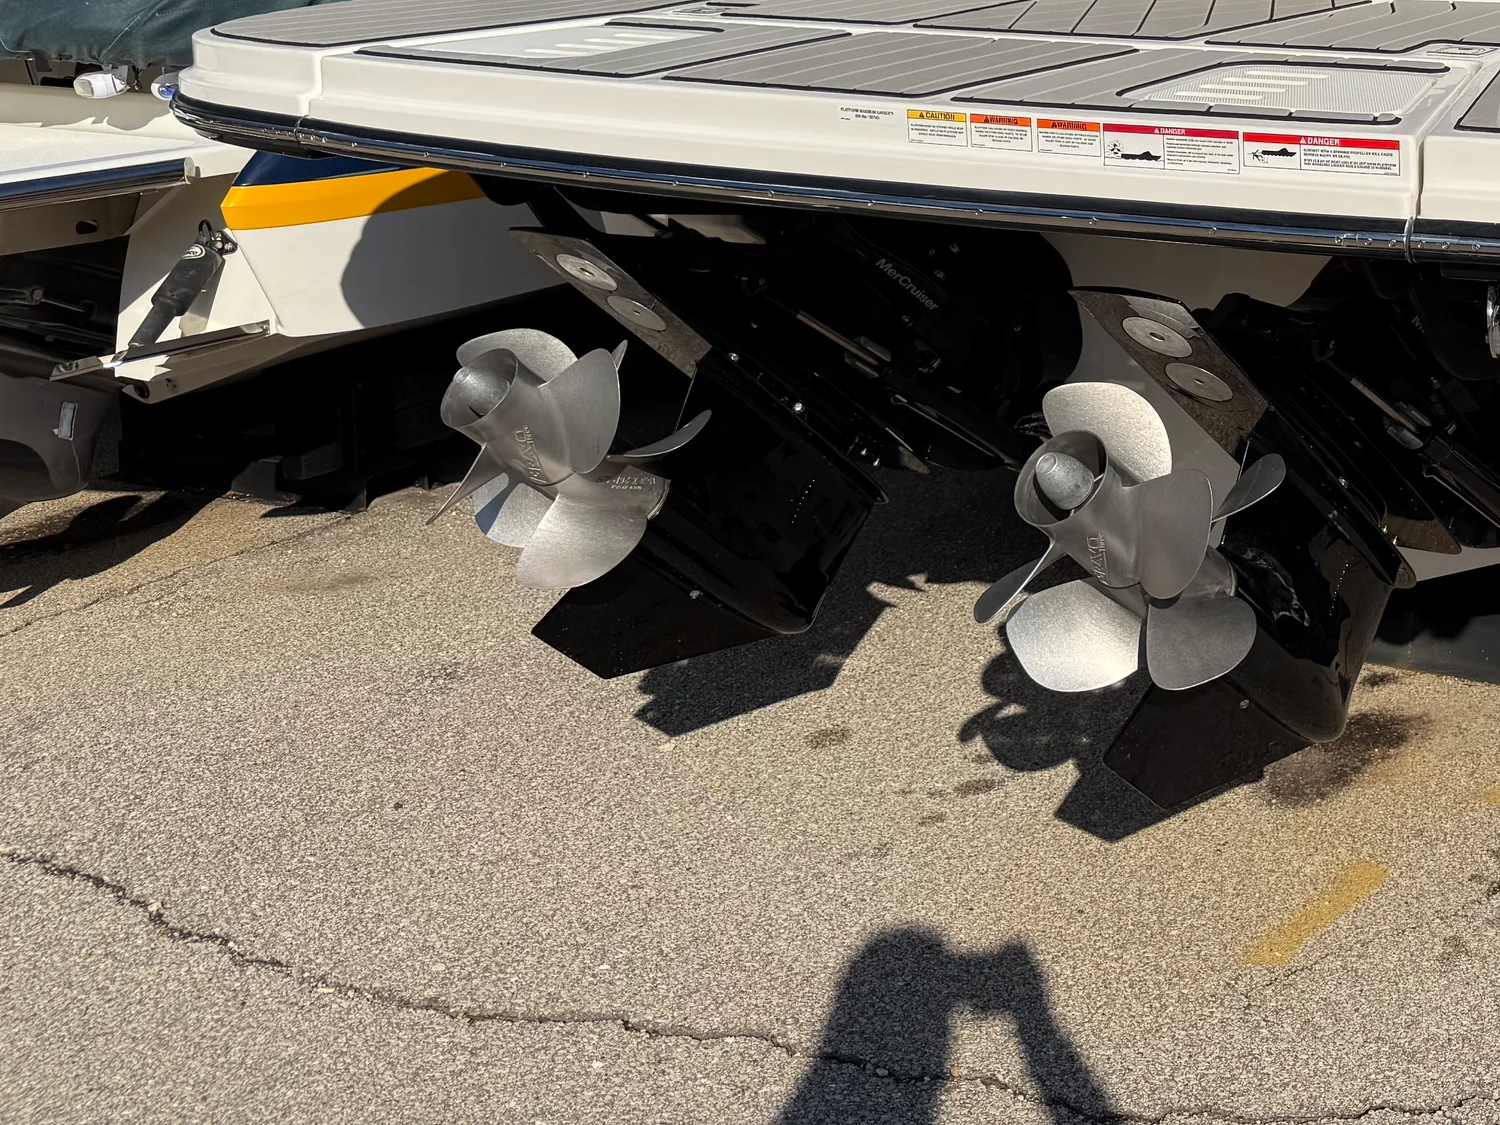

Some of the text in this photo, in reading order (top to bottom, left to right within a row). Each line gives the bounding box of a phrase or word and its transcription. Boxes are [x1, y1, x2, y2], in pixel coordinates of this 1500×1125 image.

[926, 111, 955, 120] CAUTION
[988, 116, 1018, 125] WARNING
[1057, 121, 1087, 130] WARNING
[1160, 127, 1186, 136] DANGER
[1307, 137, 1340, 146] DANGER
[875, 258, 939, 310] MerCruiser
